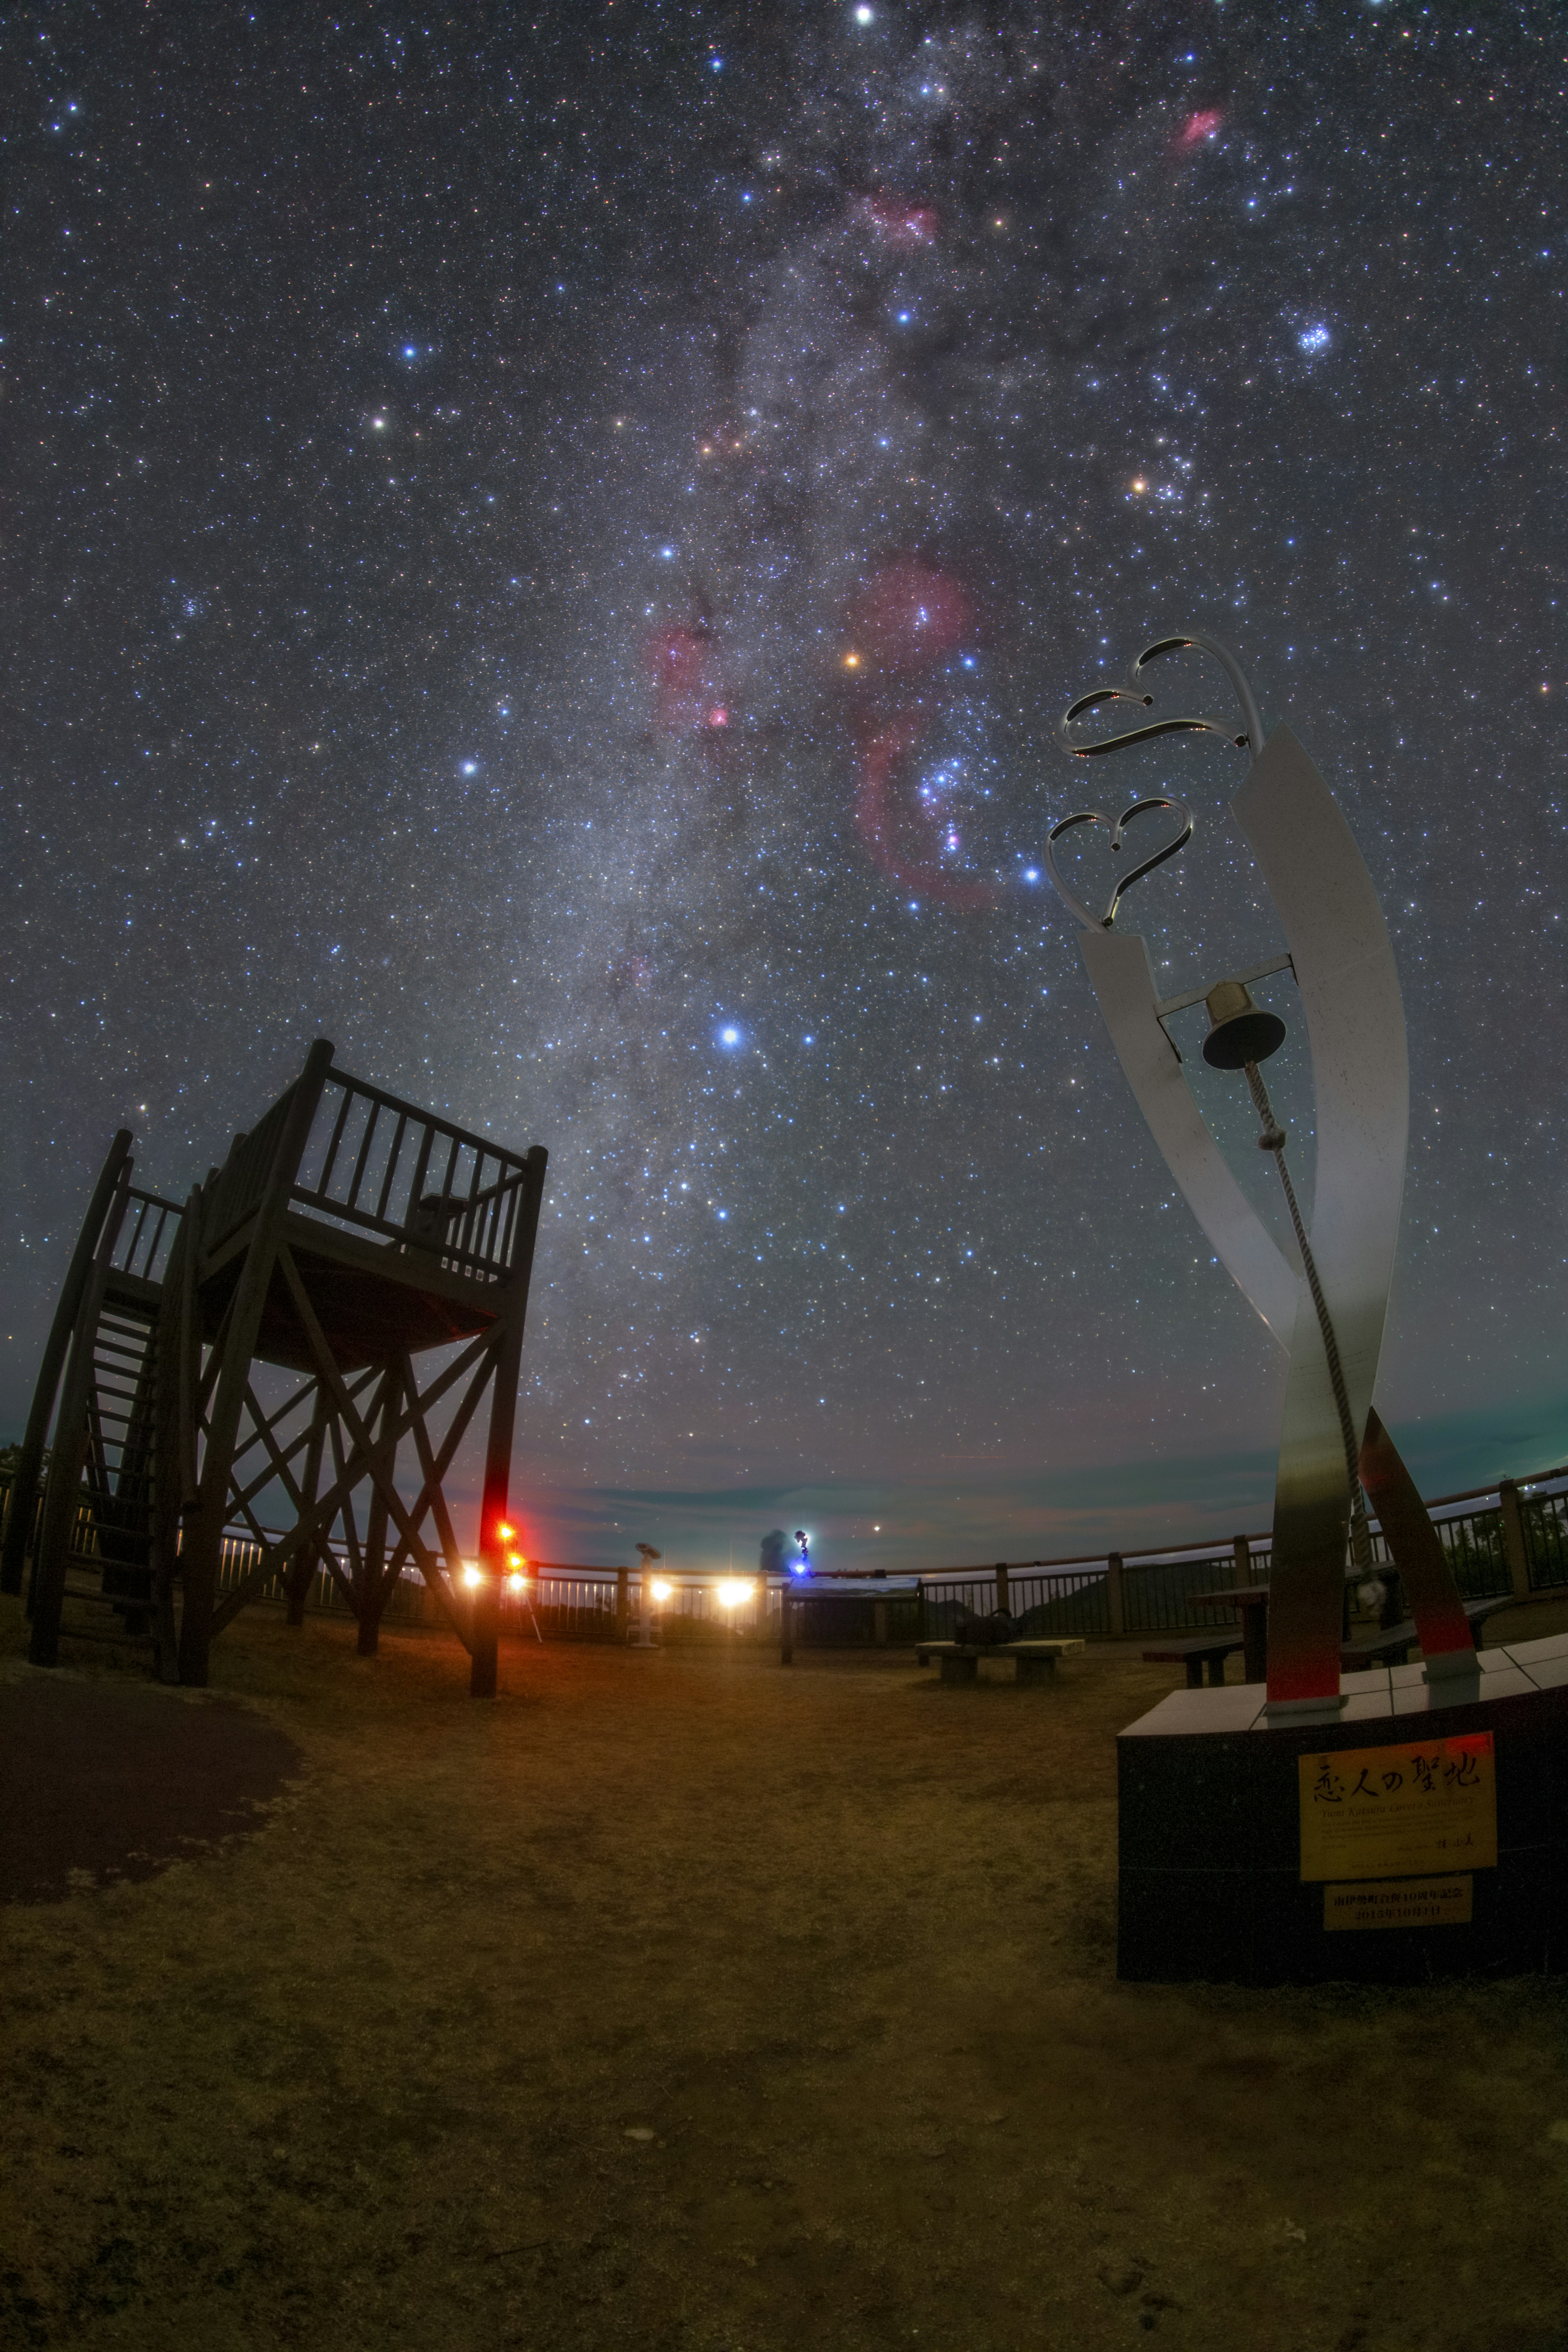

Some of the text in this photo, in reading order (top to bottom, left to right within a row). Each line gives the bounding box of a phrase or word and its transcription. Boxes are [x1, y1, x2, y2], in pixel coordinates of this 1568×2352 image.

[1314, 1751, 1480, 1802] 恋人の聖地
[1322, 1809, 1345, 1818] Yumi
[1348, 1805, 1386, 1817] Katsura
[1426, 1796, 1474, 1809] Sanctuary
